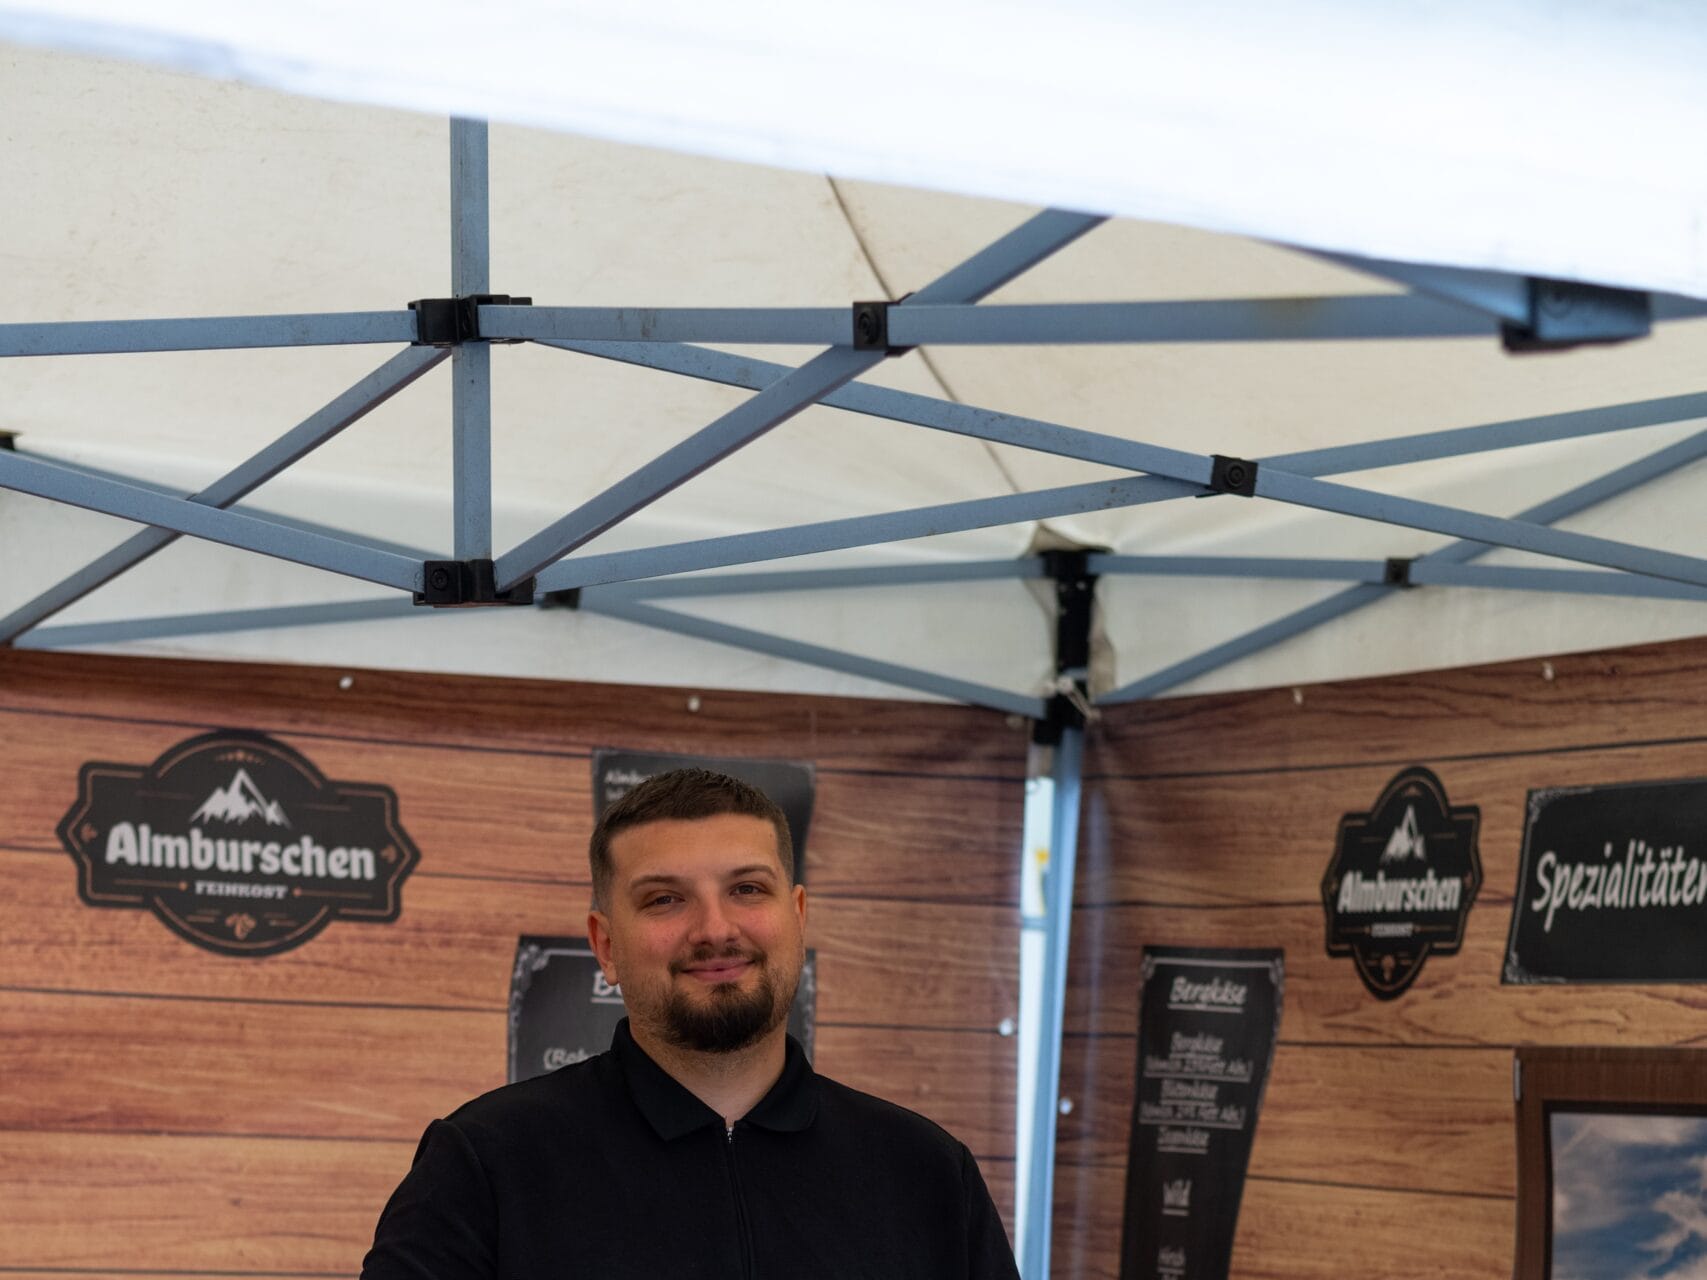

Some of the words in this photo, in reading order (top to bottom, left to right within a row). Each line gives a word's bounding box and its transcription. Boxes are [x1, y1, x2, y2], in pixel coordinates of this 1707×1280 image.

[105, 821, 376, 880] Almburschen
[195, 880, 288, 899] FEINKOST
[1336, 868, 1462, 914] Almburschen
